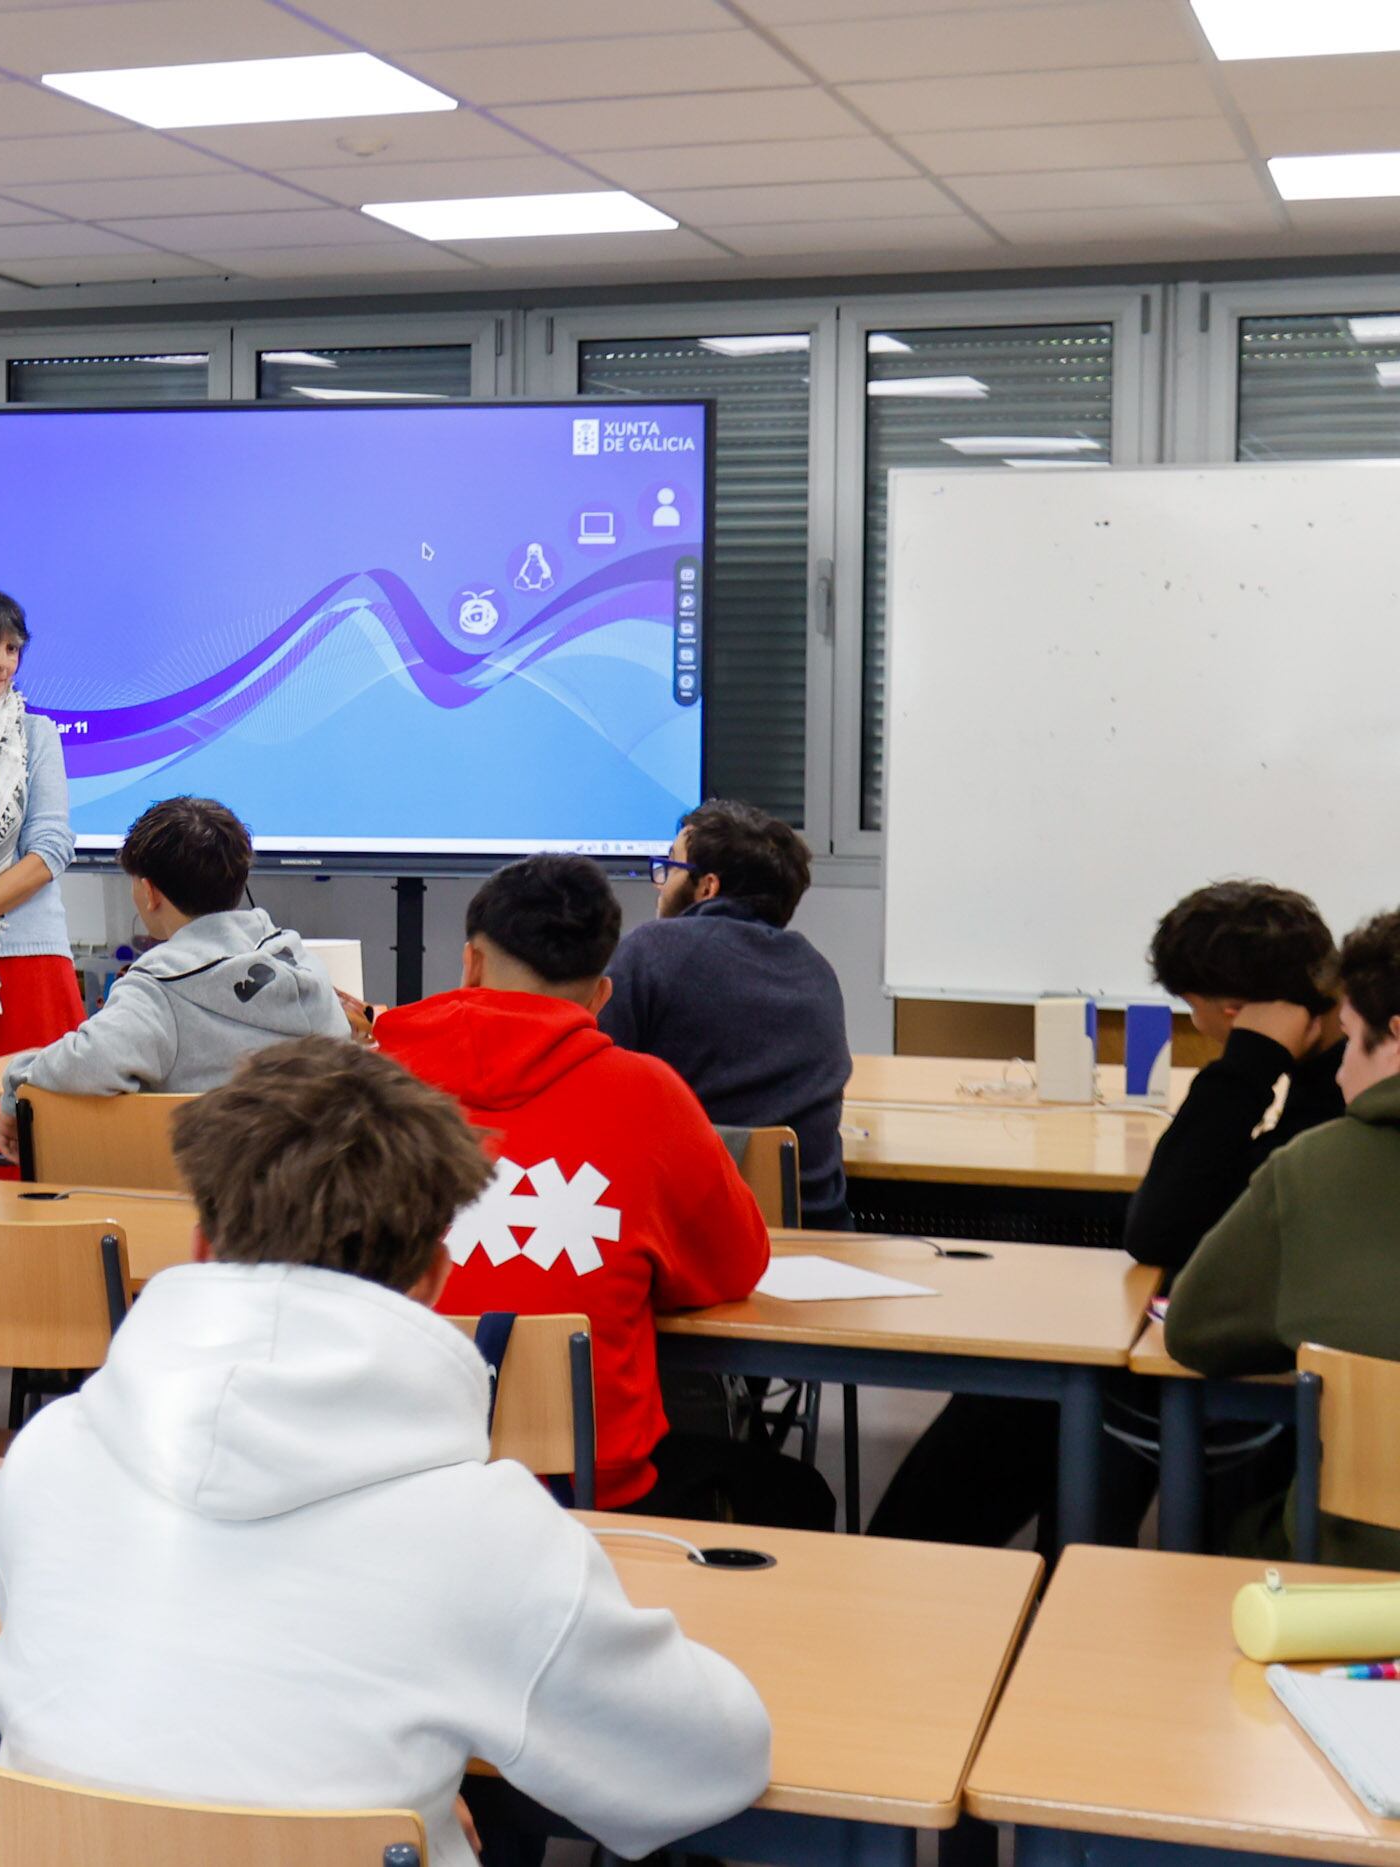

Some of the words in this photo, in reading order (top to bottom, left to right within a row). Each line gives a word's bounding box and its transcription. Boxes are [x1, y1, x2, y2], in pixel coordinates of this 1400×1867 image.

[604, 421, 661, 436] XUNTA
[603, 438, 625, 452] DE
[629, 437, 695, 452] GALICIA
[74, 720, 88, 734] 11
